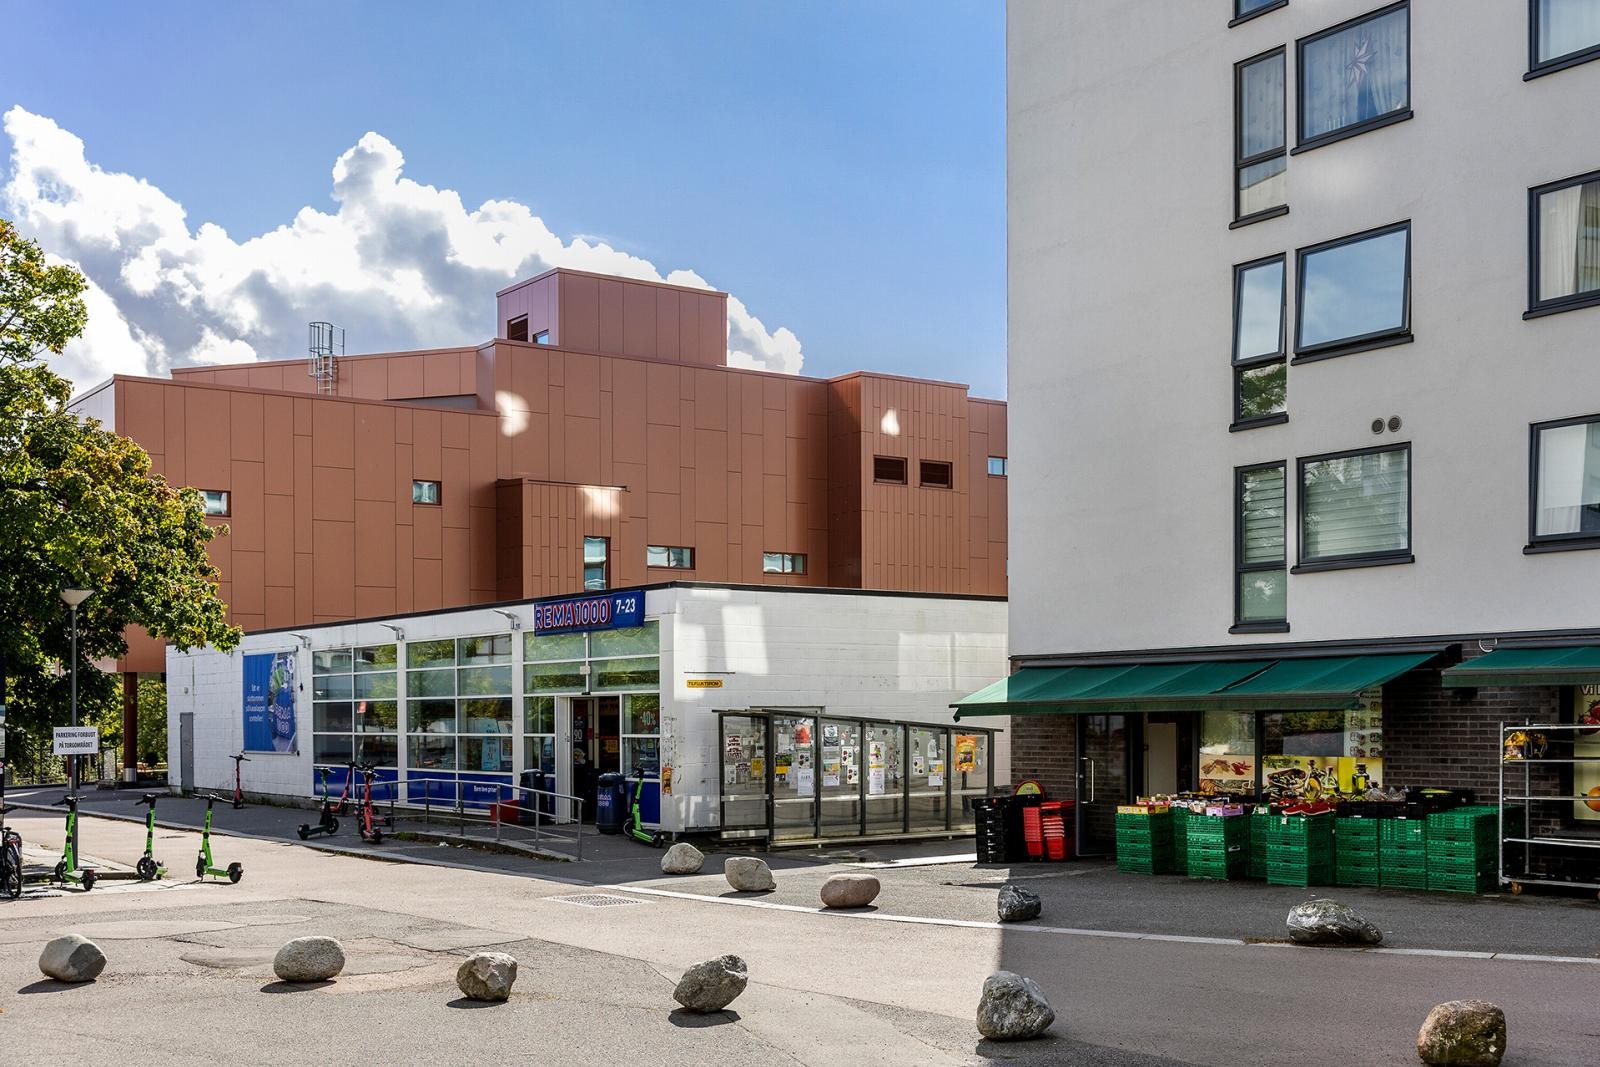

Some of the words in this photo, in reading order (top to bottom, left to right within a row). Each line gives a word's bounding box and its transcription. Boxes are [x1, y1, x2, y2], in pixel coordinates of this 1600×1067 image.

[535, 603, 574, 629] REMA
[575, 600, 611, 625] 1000
[616, 598, 636, 614] 7-23
[58, 741, 64, 749] PÅ
[64, 740, 93, 749] TORGOMRÅDET
